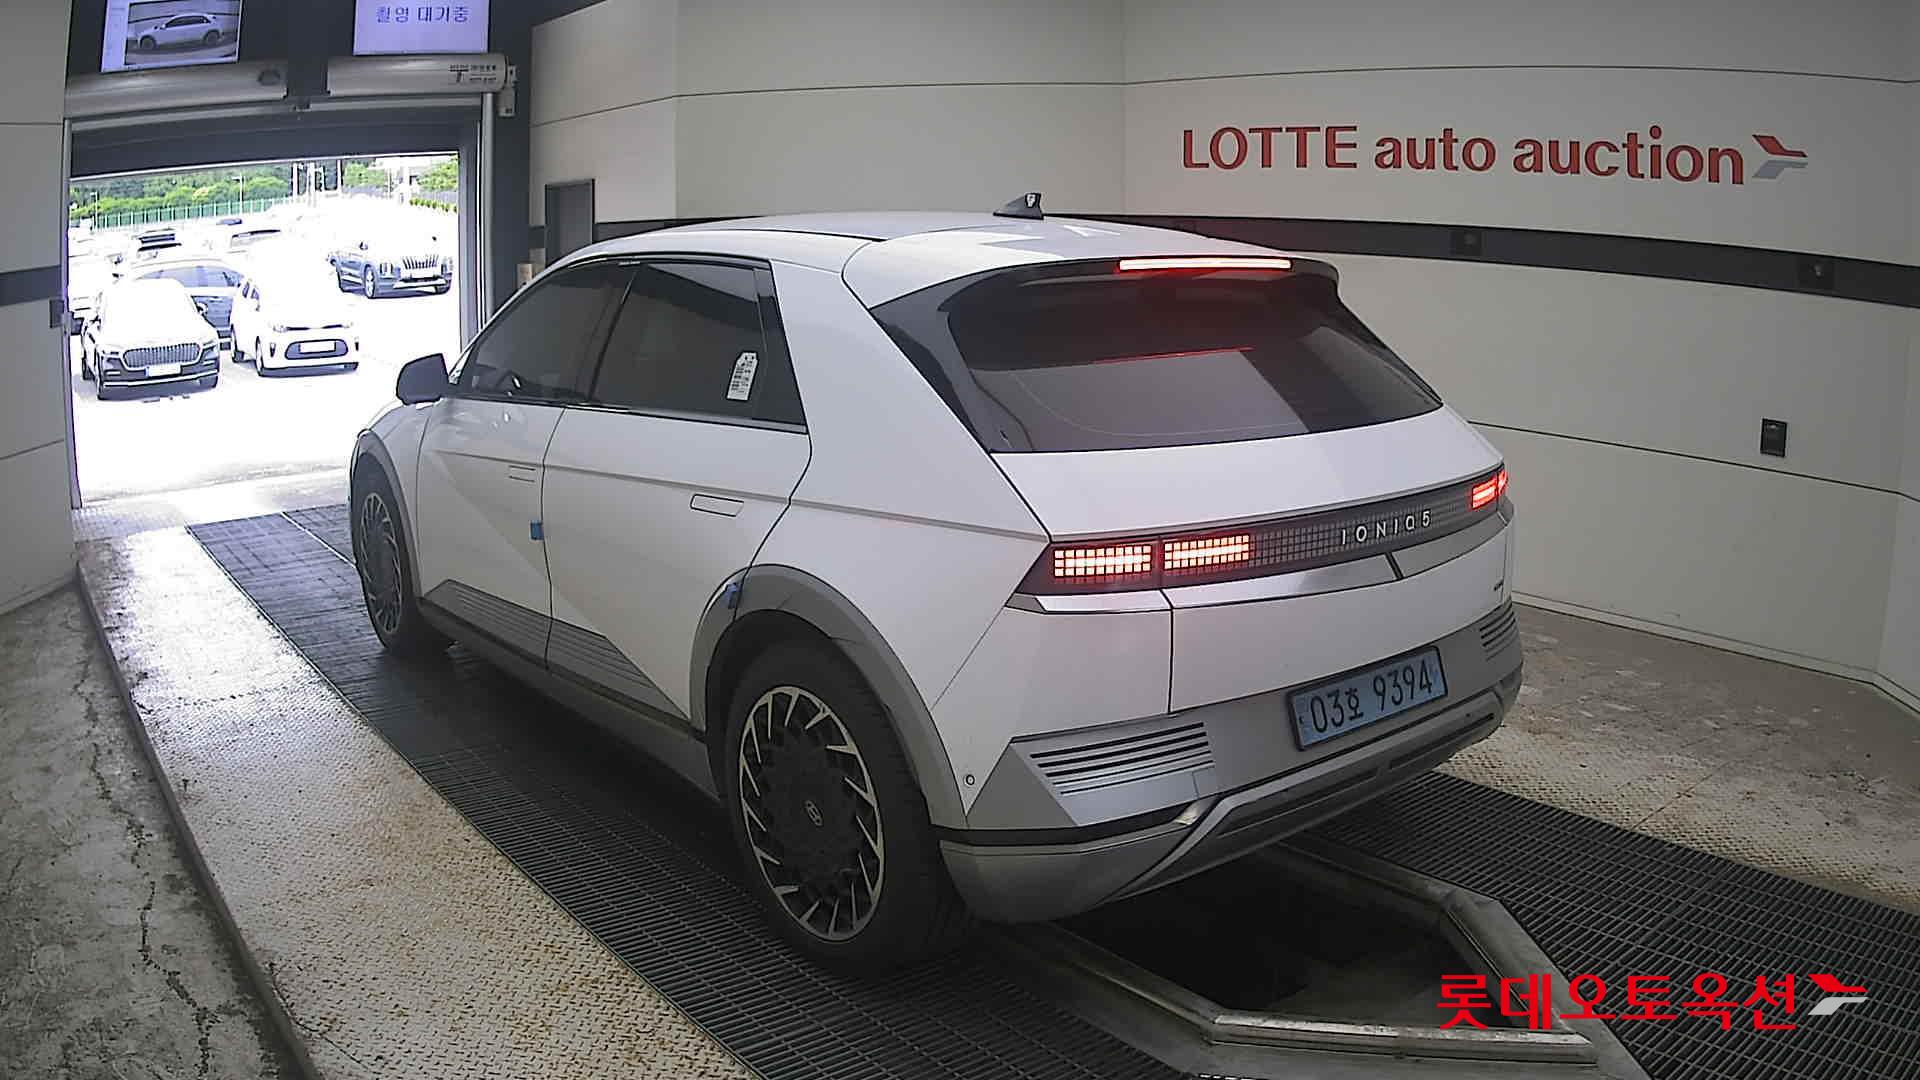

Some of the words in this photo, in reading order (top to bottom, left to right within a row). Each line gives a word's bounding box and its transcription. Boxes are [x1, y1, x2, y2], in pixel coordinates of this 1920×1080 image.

[418, 6, 468, 23] 대기중
[1183, 126, 1358, 170] LOTTE
[1375, 128, 1497, 172] auto
[1513, 125, 1744, 184] auction
[1373, 660, 1432, 712] 9394
